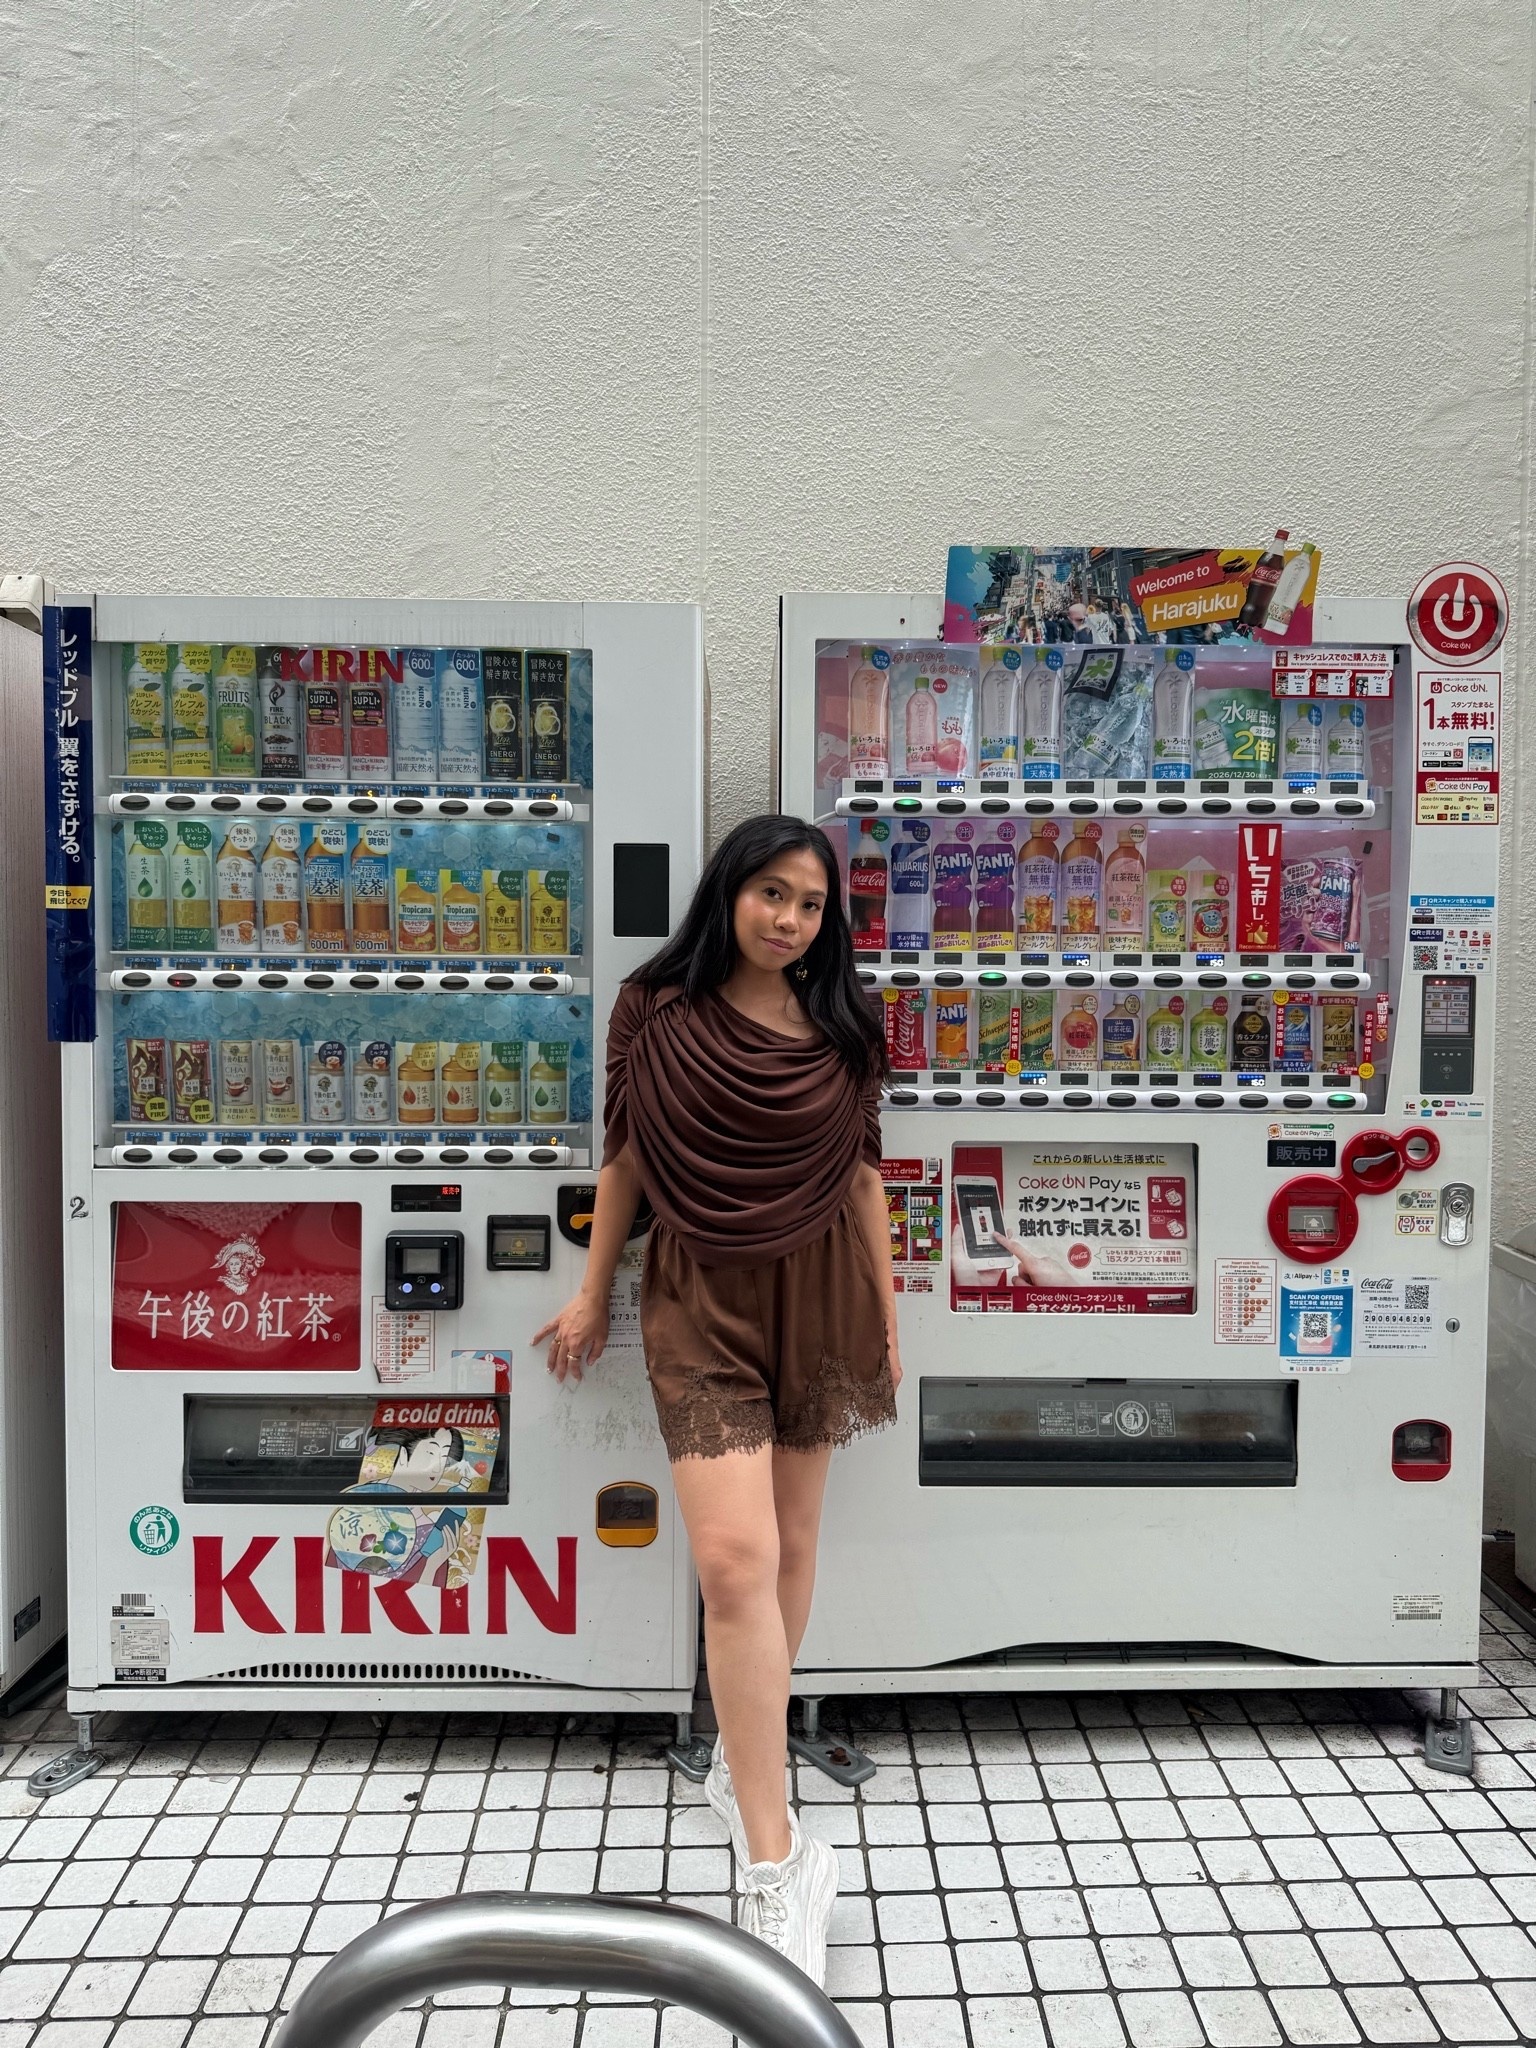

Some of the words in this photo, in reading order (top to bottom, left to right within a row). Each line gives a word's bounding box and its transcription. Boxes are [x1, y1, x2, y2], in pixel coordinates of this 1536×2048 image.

[1136, 569, 1194, 596] Welcome
[1197, 565, 1210, 577] to
[1152, 593, 1238, 622] Harajuku
[1441, 641, 1458, 649] Coke
[1459, 641, 1471, 650] ON
[485, 656, 518, 667] 冒険心を
[530, 658, 563, 670] 冒険心を
[1293, 653, 1386, 662] キャッシュレスでのご購入方法
[280, 650, 404, 683] KIRIN
[60, 629, 78, 728] レッドブル
[1443, 684, 1468, 692] Coke
[218, 691, 250, 702] FRUITS
[1221, 700, 1276, 725] 水曜日は
[1423, 698, 1495, 730] 1本無料!
[264, 716, 292, 724] BLACK
[941, 722, 963, 735] もも
[1232, 730, 1276, 763] 2倍!
[396, 764, 434, 773] 国産天然水
[441, 764, 479, 773] 国産天然水
[1030, 771, 1055, 779] 天然水
[1160, 771, 1185, 779] 天然水
[1459, 782, 1471, 790] ON
[1473, 783, 1488, 792] Pay
[59, 737, 80, 863] 翼をさずける。
[323, 836, 344, 845] 爽快!
[368, 837, 389, 846] 爽快!
[140, 857, 150, 875] 生茶
[183, 857, 193, 875] 生茶
[893, 861, 929, 872] AQUARIUS
[933, 852, 973, 870] FANTA
[975, 852, 1015, 870] FANTA
[1024, 865, 1055, 874] 紅茶花伝
[1067, 865, 1097, 874] 紅茶花伝
[1244, 827, 1277, 920] いちおし
[1028, 875, 1050, 885] 無糖
[1071, 875, 1093, 885] 無糖
[1111, 873, 1141, 882] 紅茶花伝
[49, 889, 72, 897] 今日も
[310, 880, 339, 895] 麦茶
[355, 880, 383, 896] 麦茶
[1283, 884, 1308, 900] 炭酸
[402, 904, 432, 914] Tropicana
[446, 904, 476, 914] Tropicana
[1160, 926, 1177, 934] Qoo
[1203, 925, 1221, 934] Qoo
[311, 940, 343, 949] 600ml
[356, 940, 388, 949] 600ml
[1019, 942, 1056, 950] アールグレイ
[1063, 942, 1099, 950] アールグレイ
[886, 1005, 895, 1052] お手頃価格!
[894, 999, 915, 1057] Coca-Co
[1108, 1025, 1132, 1033] 紅茶花伝
[1160, 1025, 1173, 1048] 綾鷹
[1204, 1025, 1217, 1048] 綾鷹
[421, 1086, 430, 1104] 生茶
[464, 1086, 473, 1104] 生茶
[504, 1087, 513, 1106] 生茶
[551, 1087, 560, 1106] 生茶
[1033, 1155, 1165, 1164] これからの新しい生活様式に
[1276, 1146, 1328, 1161] 販売中
[1019, 1177, 1058, 1189] Coke
[1062, 1174, 1085, 1189] ON
[1089, 1177, 1121, 1192] Pay
[1124, 1181, 1141, 1190] なら
[442, 1187, 460, 1195] 販売中
[576, 1187, 597, 1195] おつり・
[69, 1196, 90, 1219] 2
[1019, 1196, 1140, 1213] ボタンやコインに
[1019, 1218, 1141, 1237] 触れずに買える!
[138, 1290, 335, 1342] 午後の紅茶
[382, 1408, 394, 1424] a
[397, 1404, 438, 1424] cold
[444, 1403, 495, 1425] drink
[340, 1511, 364, 1537] 涼
[139, 1541, 174, 1555] リサイクル
